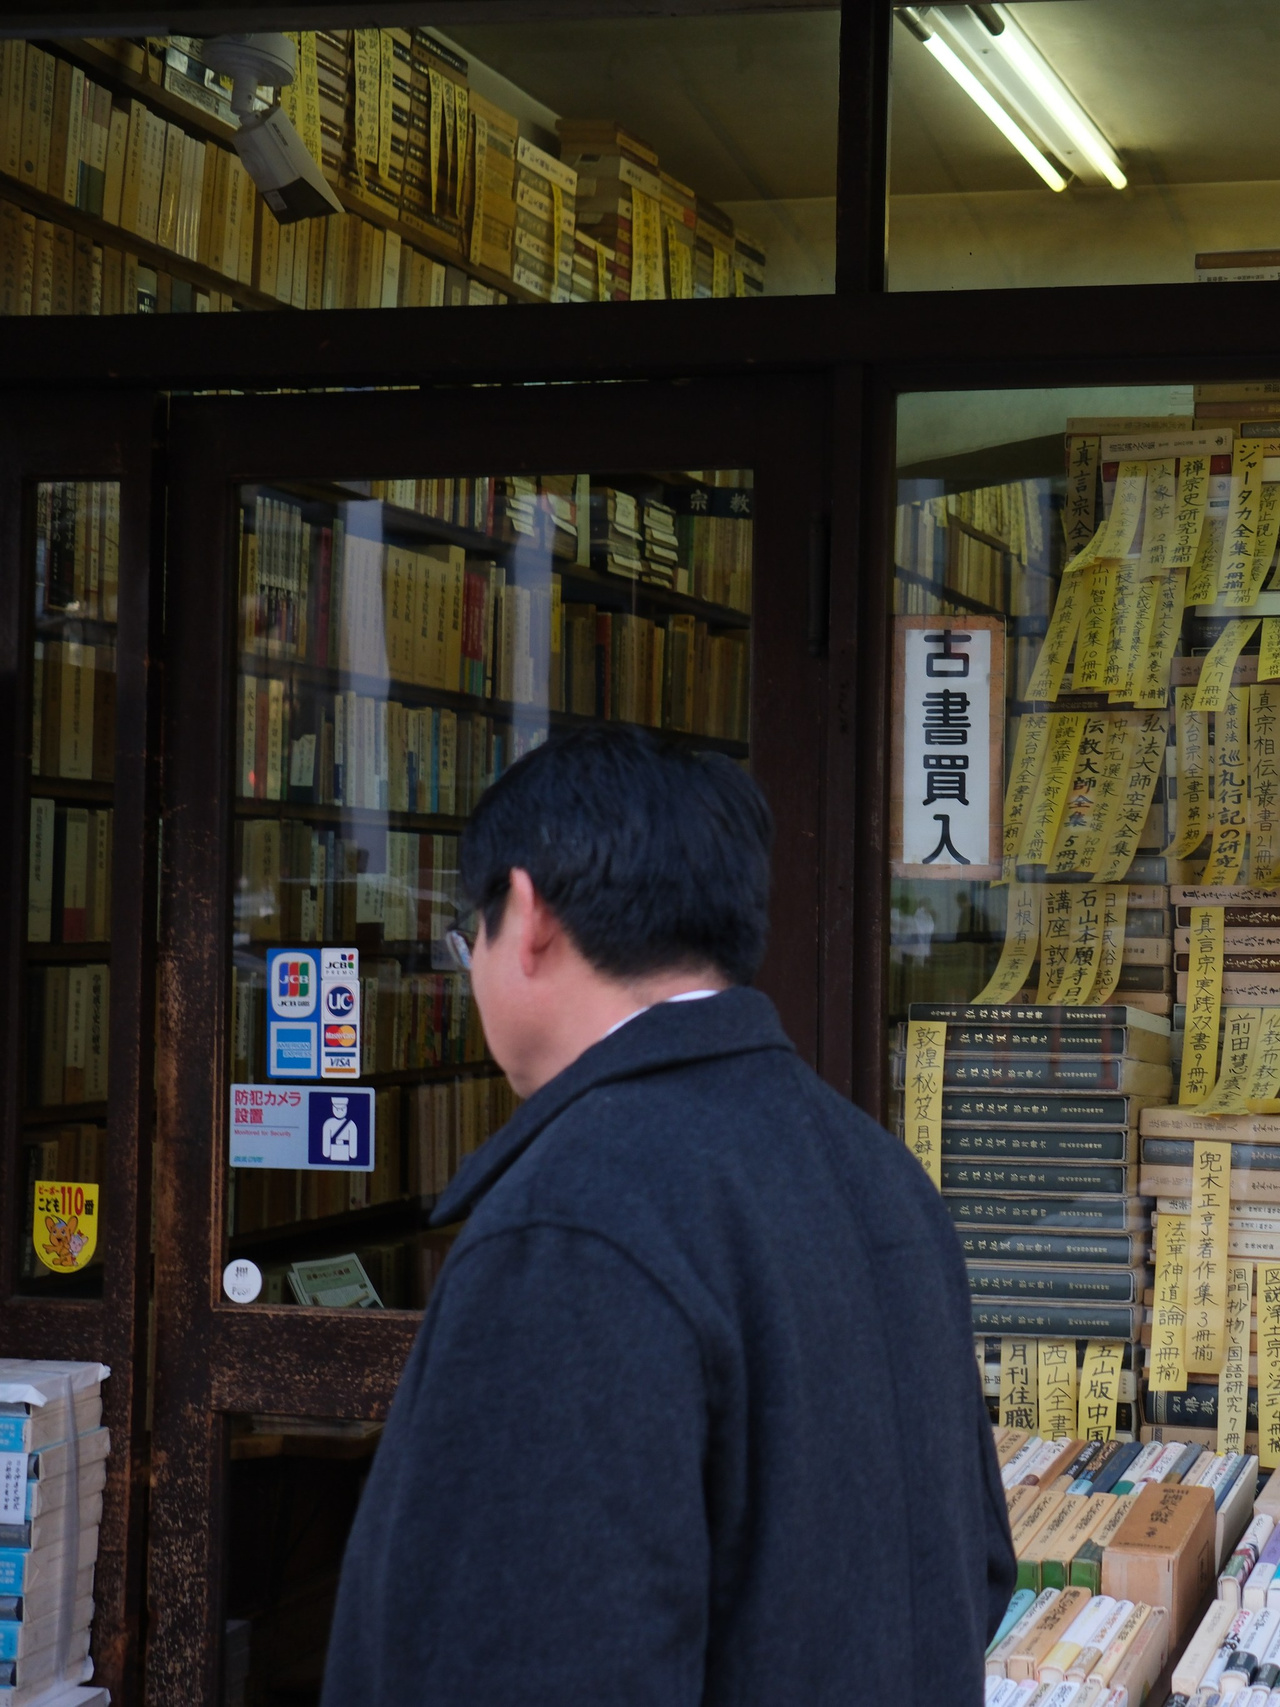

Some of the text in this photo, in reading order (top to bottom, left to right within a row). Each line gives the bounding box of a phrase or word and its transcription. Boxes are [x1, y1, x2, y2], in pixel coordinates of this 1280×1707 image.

[922, 630, 973, 864] 古書買入
[325, 961, 348, 969] JCB
[279, 974, 310, 985] JCB
[330, 1058, 350, 1067] VISA
[234, 1089, 301, 1107] 防犯カメラ
[234, 1108, 264, 1125] 設置
[1155, 1221, 1188, 1383] 法華神道論3冊揃
[1004, 1343, 1036, 1430] 月刊住職
